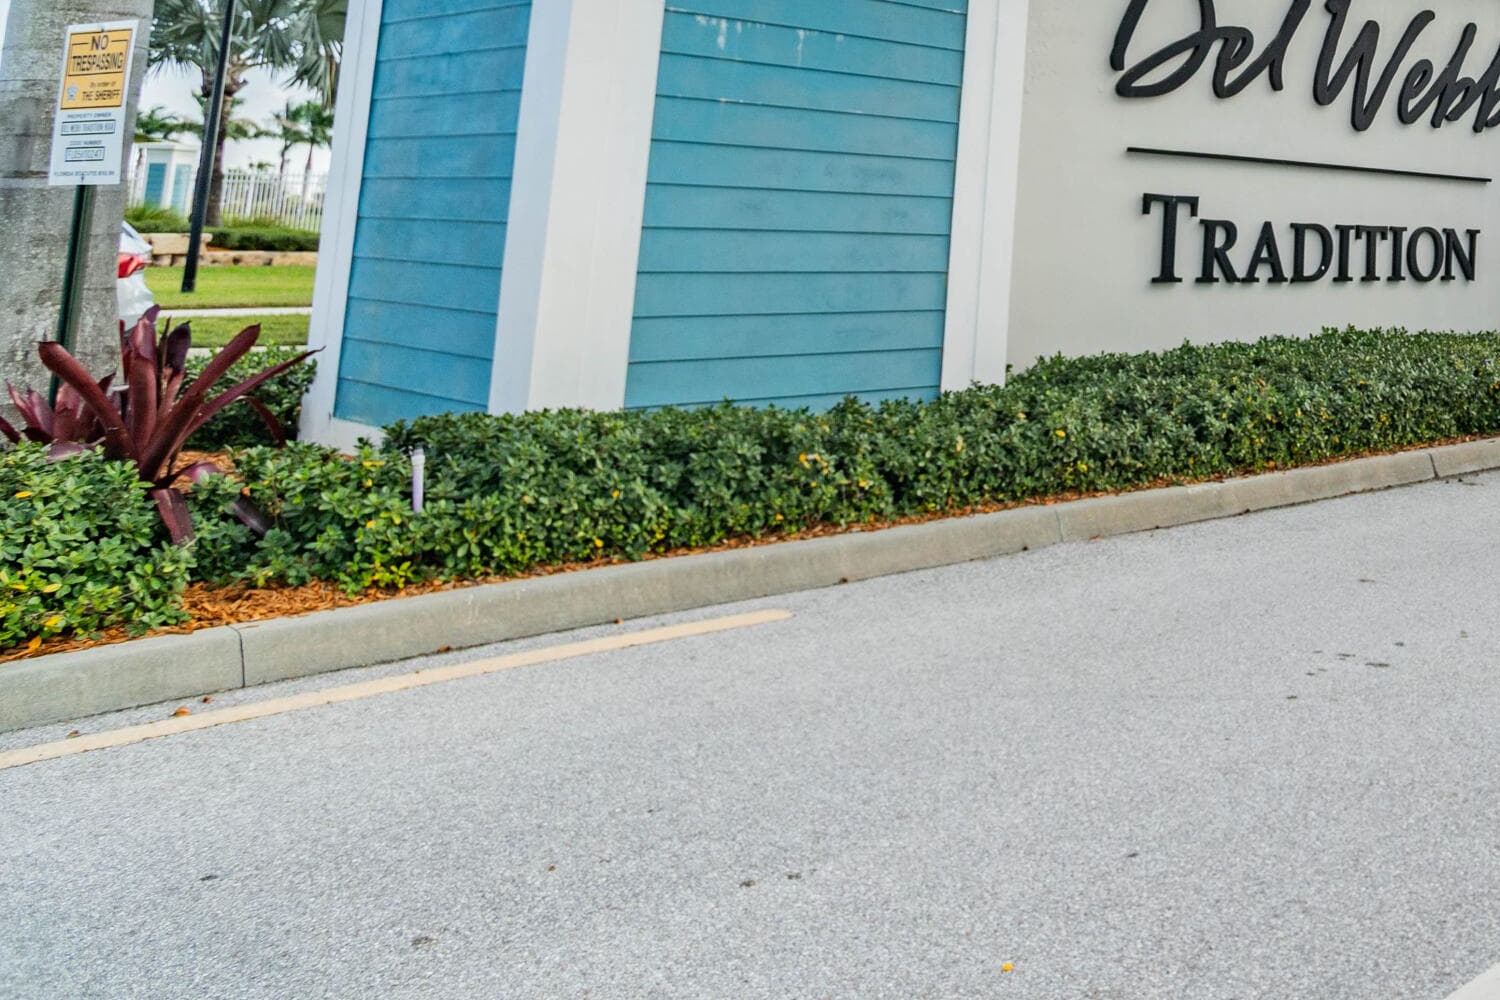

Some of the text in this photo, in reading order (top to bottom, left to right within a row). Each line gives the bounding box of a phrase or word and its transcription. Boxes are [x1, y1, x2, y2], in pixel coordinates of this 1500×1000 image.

[91, 34, 109, 51] NO
[72, 52, 124, 72] TRESPASSING
[82, 89, 121, 101] THE SHERIFF
[1142, 192, 1481, 284] TRADITION
